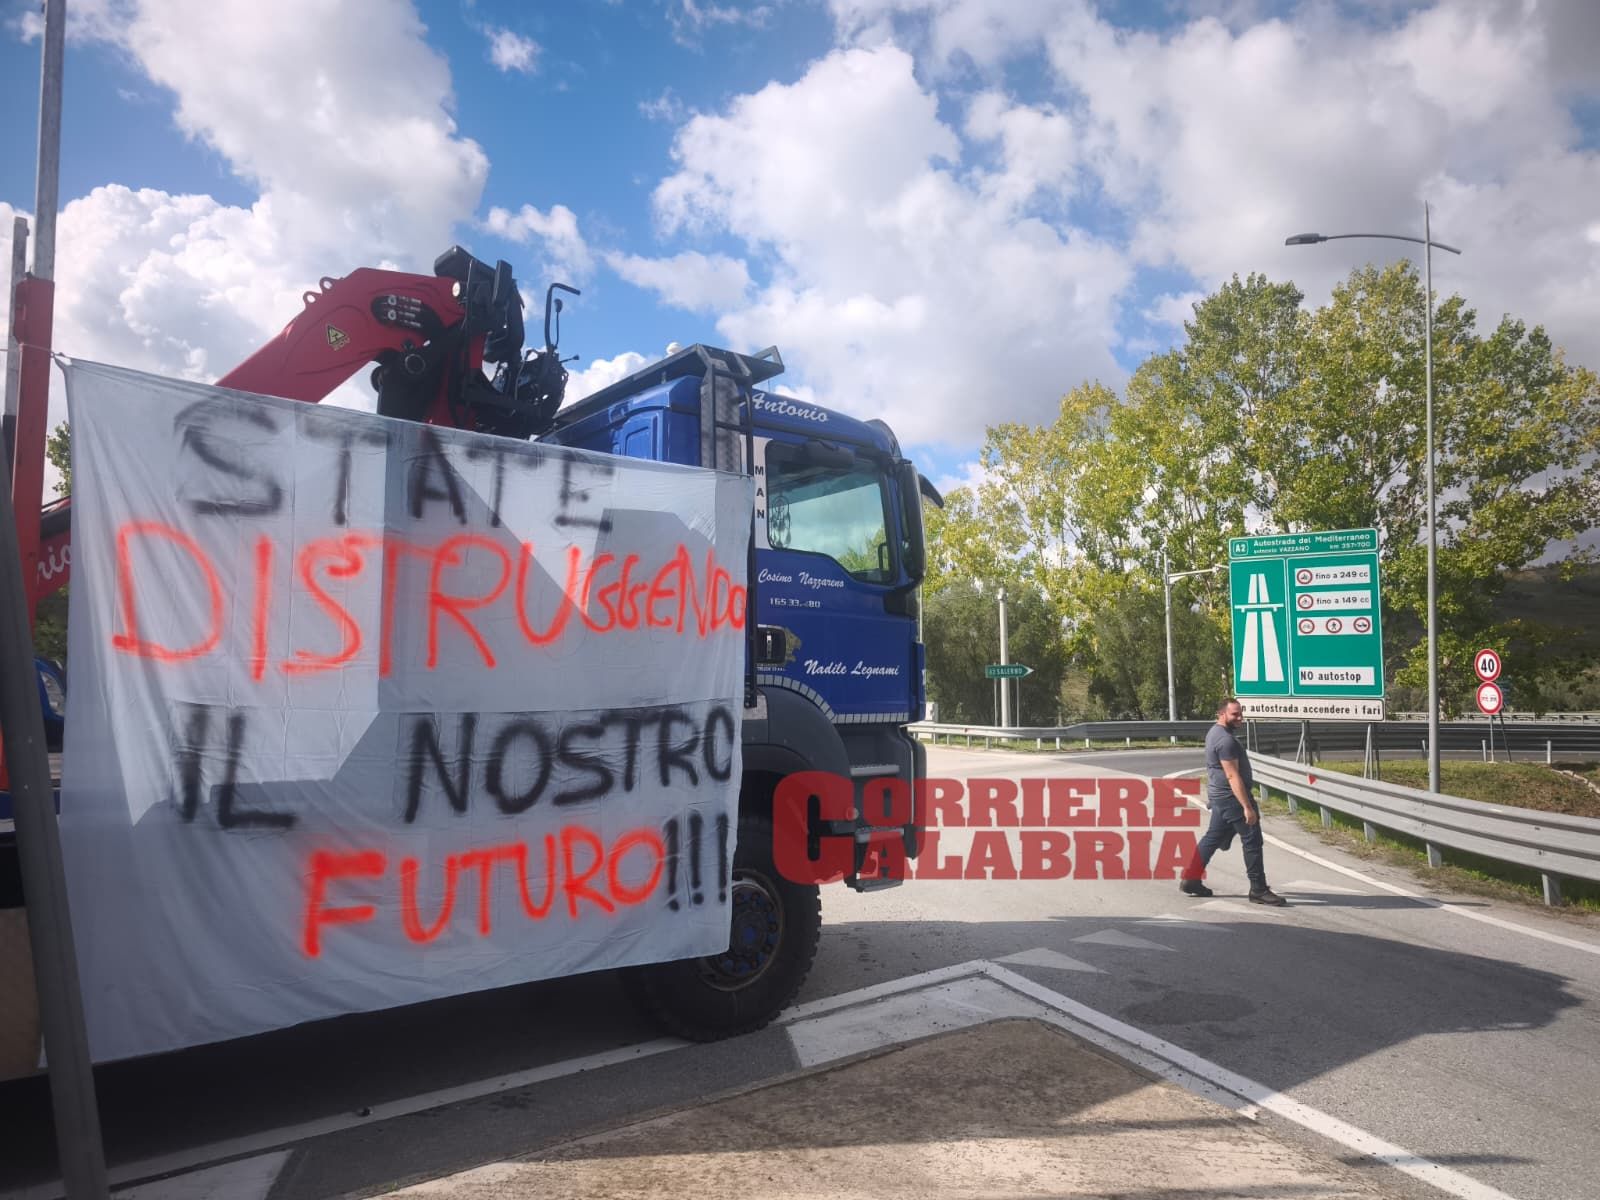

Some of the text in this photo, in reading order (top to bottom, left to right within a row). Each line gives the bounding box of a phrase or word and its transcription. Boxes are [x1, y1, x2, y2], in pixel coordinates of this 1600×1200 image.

[749, 392, 828, 422] Antonio
[174, 398, 615, 533] STATE
[755, 465, 765, 519] MAN
[1254, 538, 1296, 547] Autostrada
[1315, 533, 1371, 543] Mediterraneo
[1235, 543, 1246, 553] A2
[1280, 545, 1310, 553] VAZZANO
[758, 568, 844, 589] Cosimo Nazzareno
[1315, 572, 1331, 580] fino
[1340, 571, 1357, 579] 249
[112, 521, 747, 682] DISTRUGGENDO
[1316, 597, 1332, 605] fino
[1341, 596, 1357, 604] 149
[804, 659, 847, 676] Nadile
[851, 661, 900, 680] Legnami
[1480, 658, 1495, 673] 40
[1300, 671, 1361, 684] NO autostop
[1250, 703, 1299, 713] autostrada
[1303, 704, 1350, 714] accendere
[1362, 704, 1381, 715] fari
[171, 703, 734, 830] IL NOSTRO
